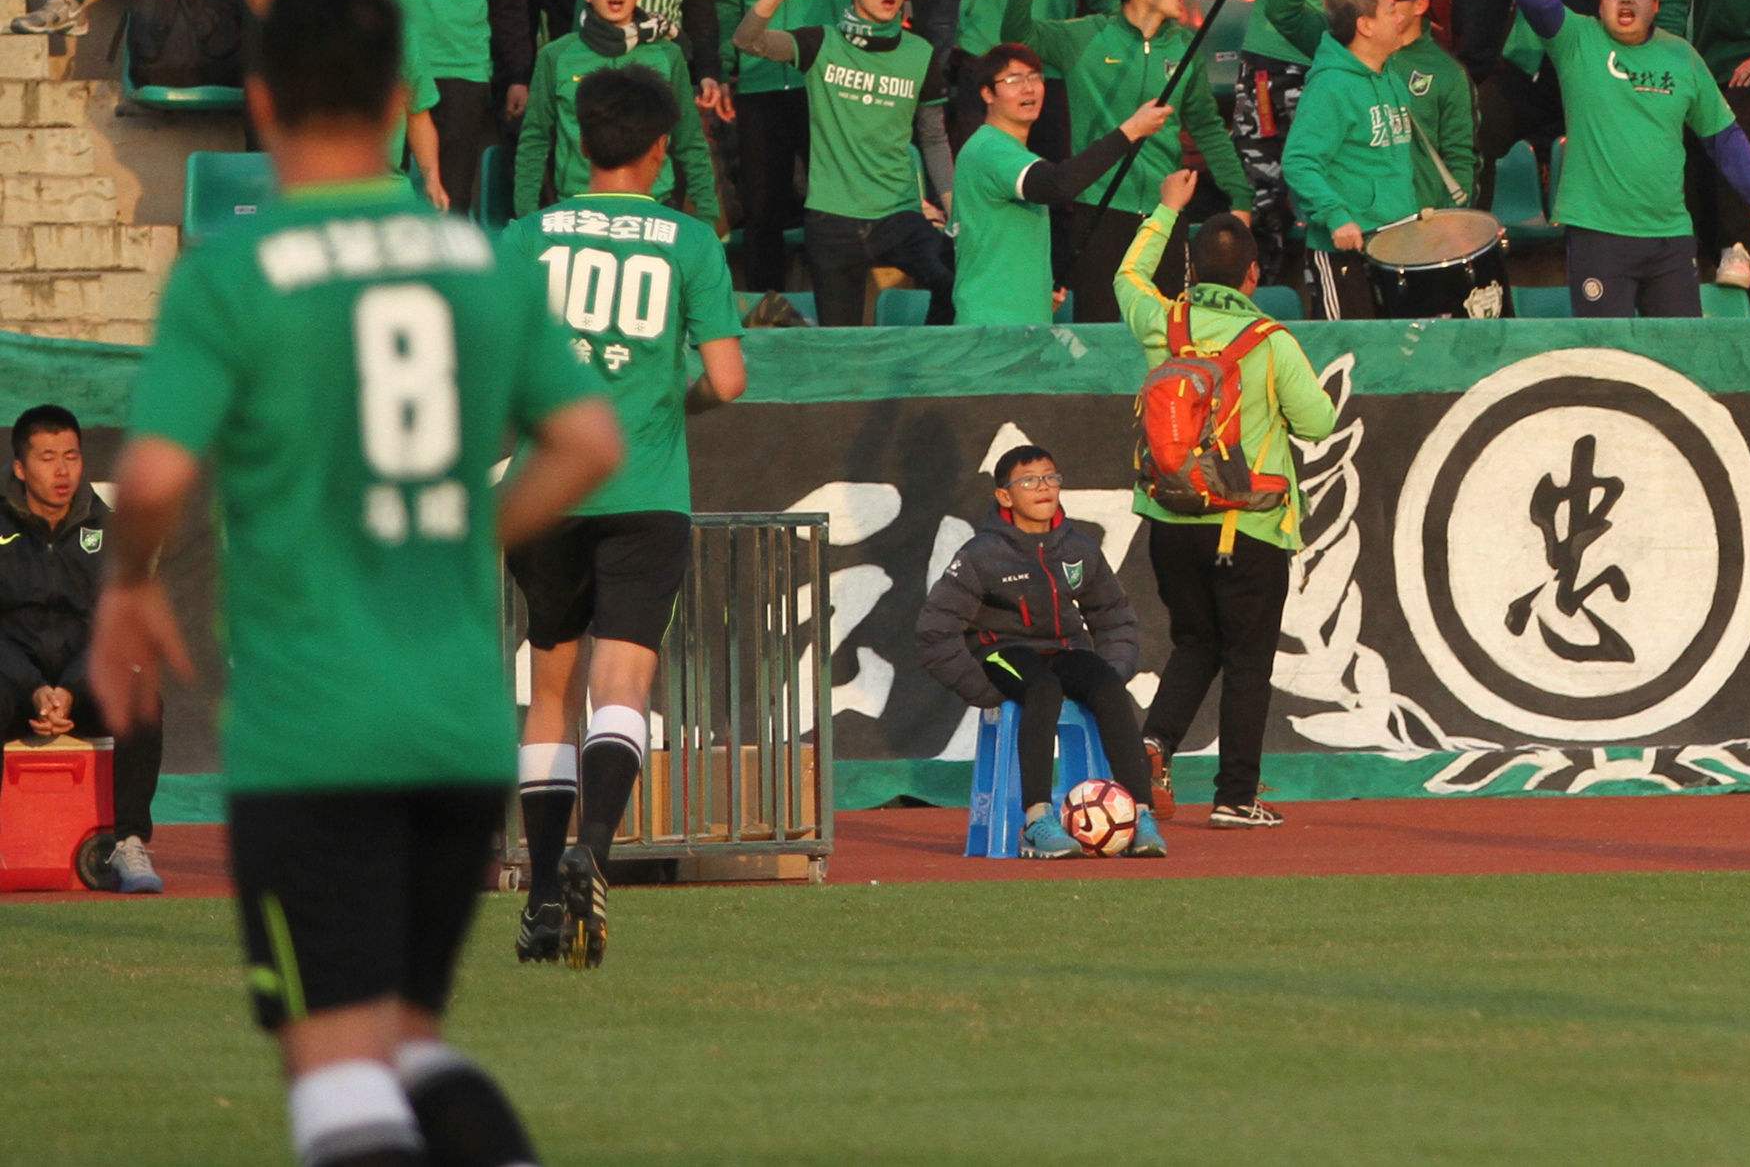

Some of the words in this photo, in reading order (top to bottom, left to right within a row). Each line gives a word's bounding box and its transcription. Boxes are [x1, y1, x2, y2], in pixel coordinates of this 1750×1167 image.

[824, 64, 875, 92] GREEN
[879, 75, 916, 100] SOUL
[541, 209, 678, 244] 東芝空调
[538, 245, 671, 339] 100
[353, 280, 461, 482] 8
[1002, 573, 1030, 583] KELME
[1504, 433, 1636, 663] 忠
